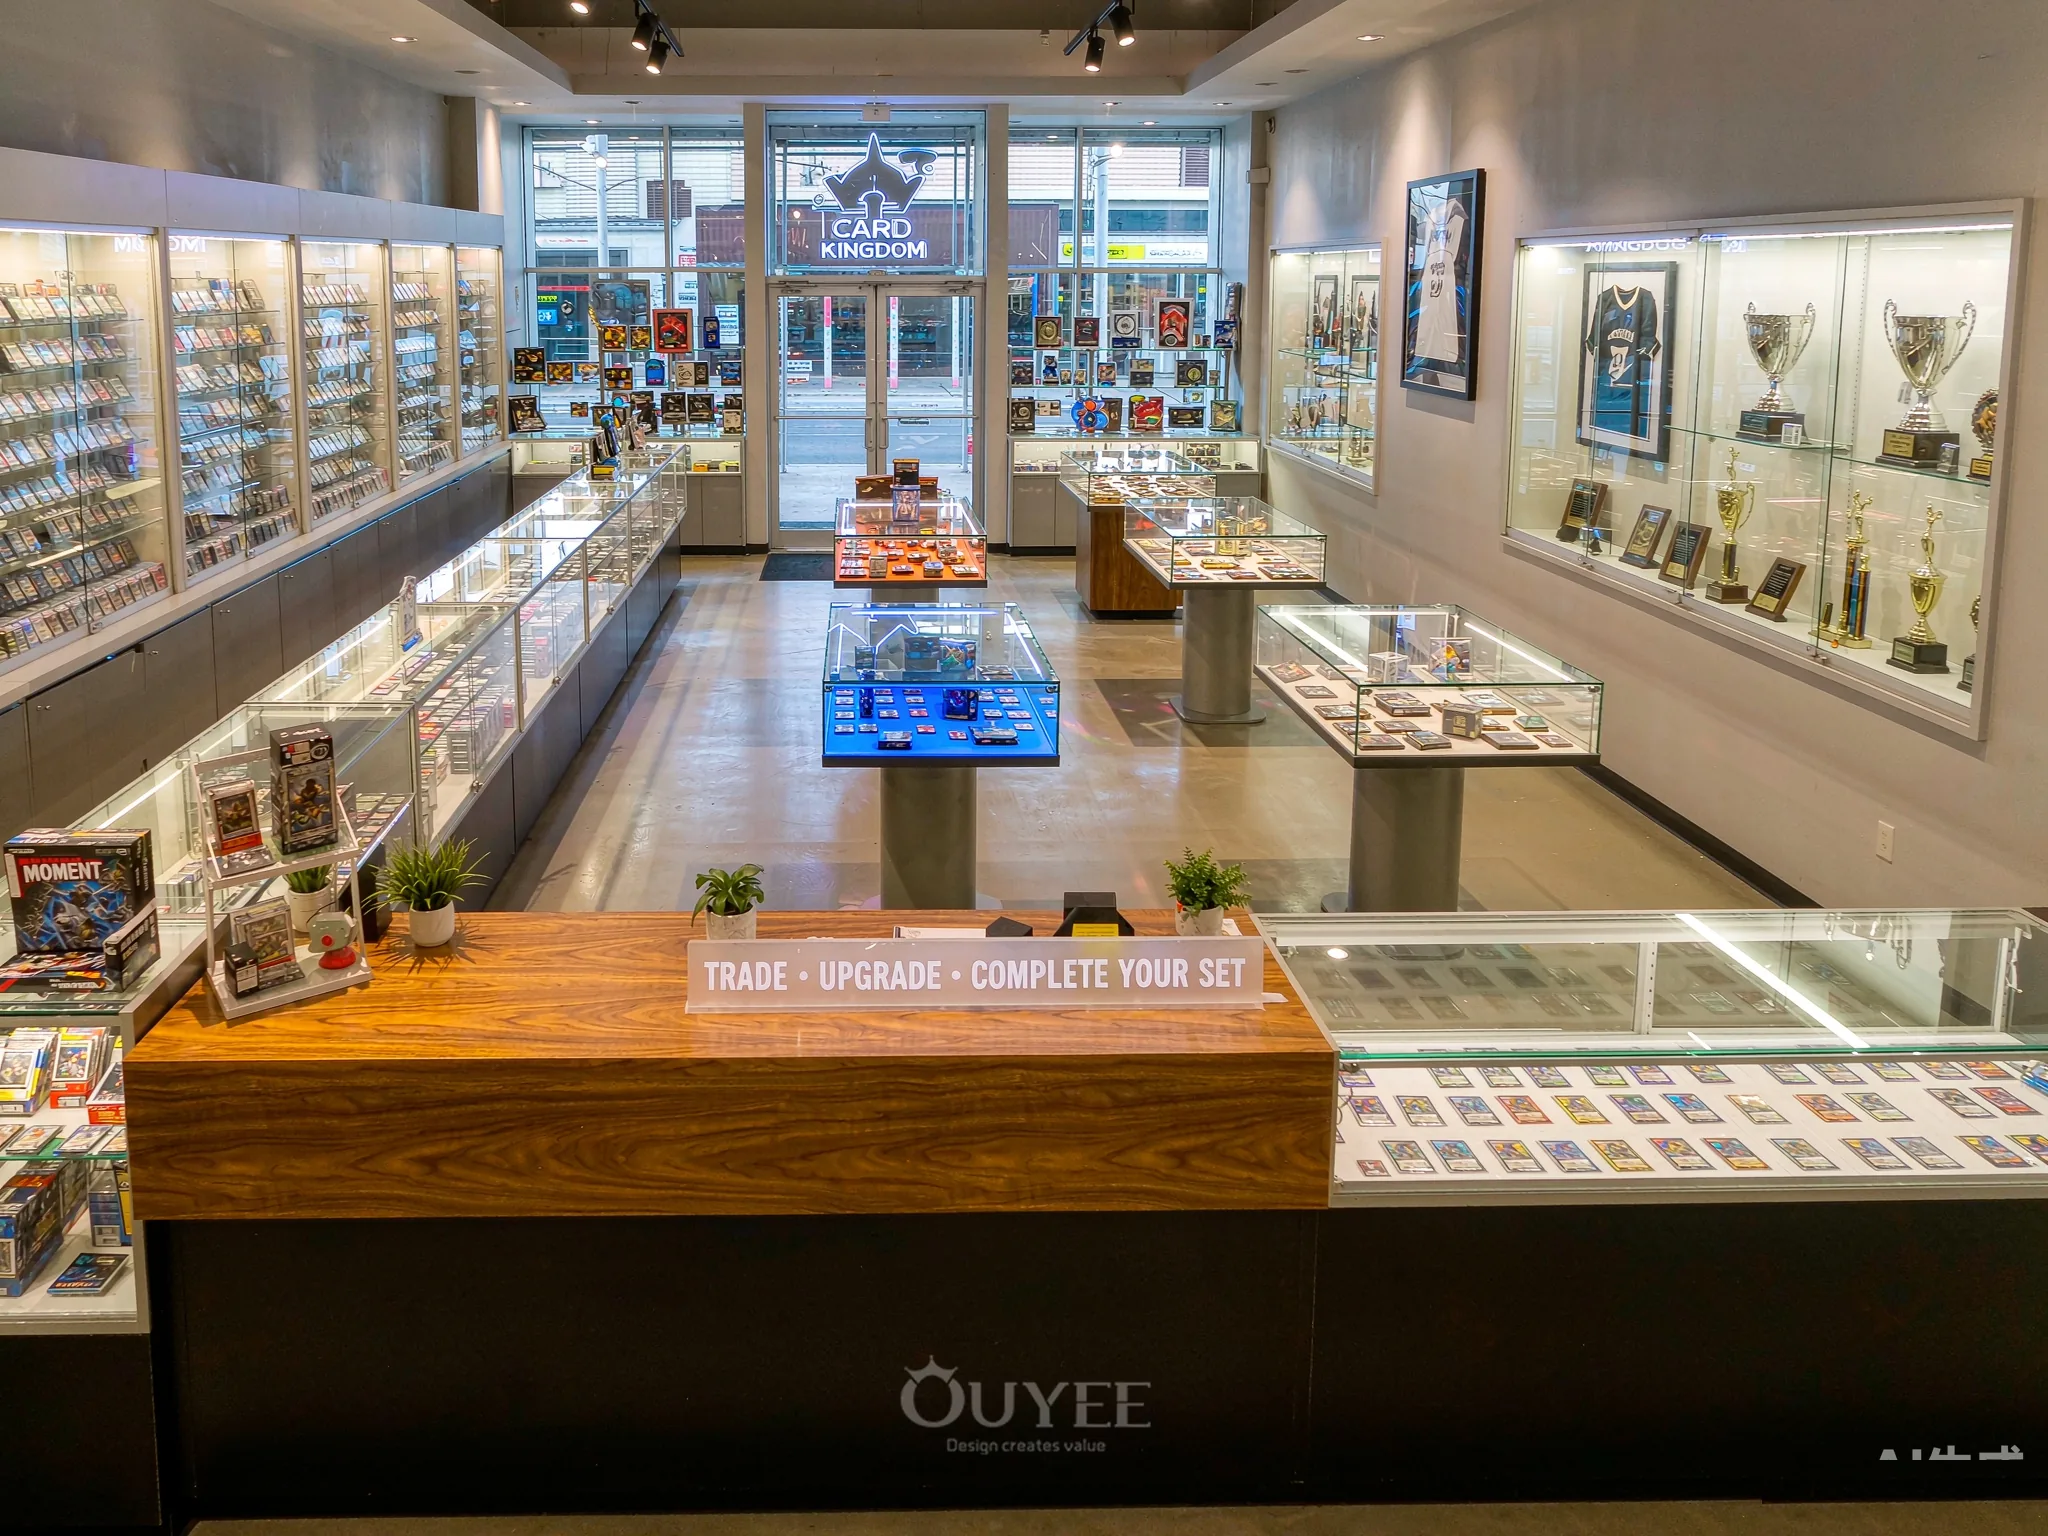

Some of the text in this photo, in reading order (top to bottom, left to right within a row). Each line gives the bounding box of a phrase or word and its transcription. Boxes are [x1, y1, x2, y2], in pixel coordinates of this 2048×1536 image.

[832, 218, 912, 239] CARD
[821, 241, 928, 259] KINGDOM
[23, 861, 103, 883] MOMENT
[705, 957, 1246, 991] TRADE UPGRADE COMPLETE YOUR SET
